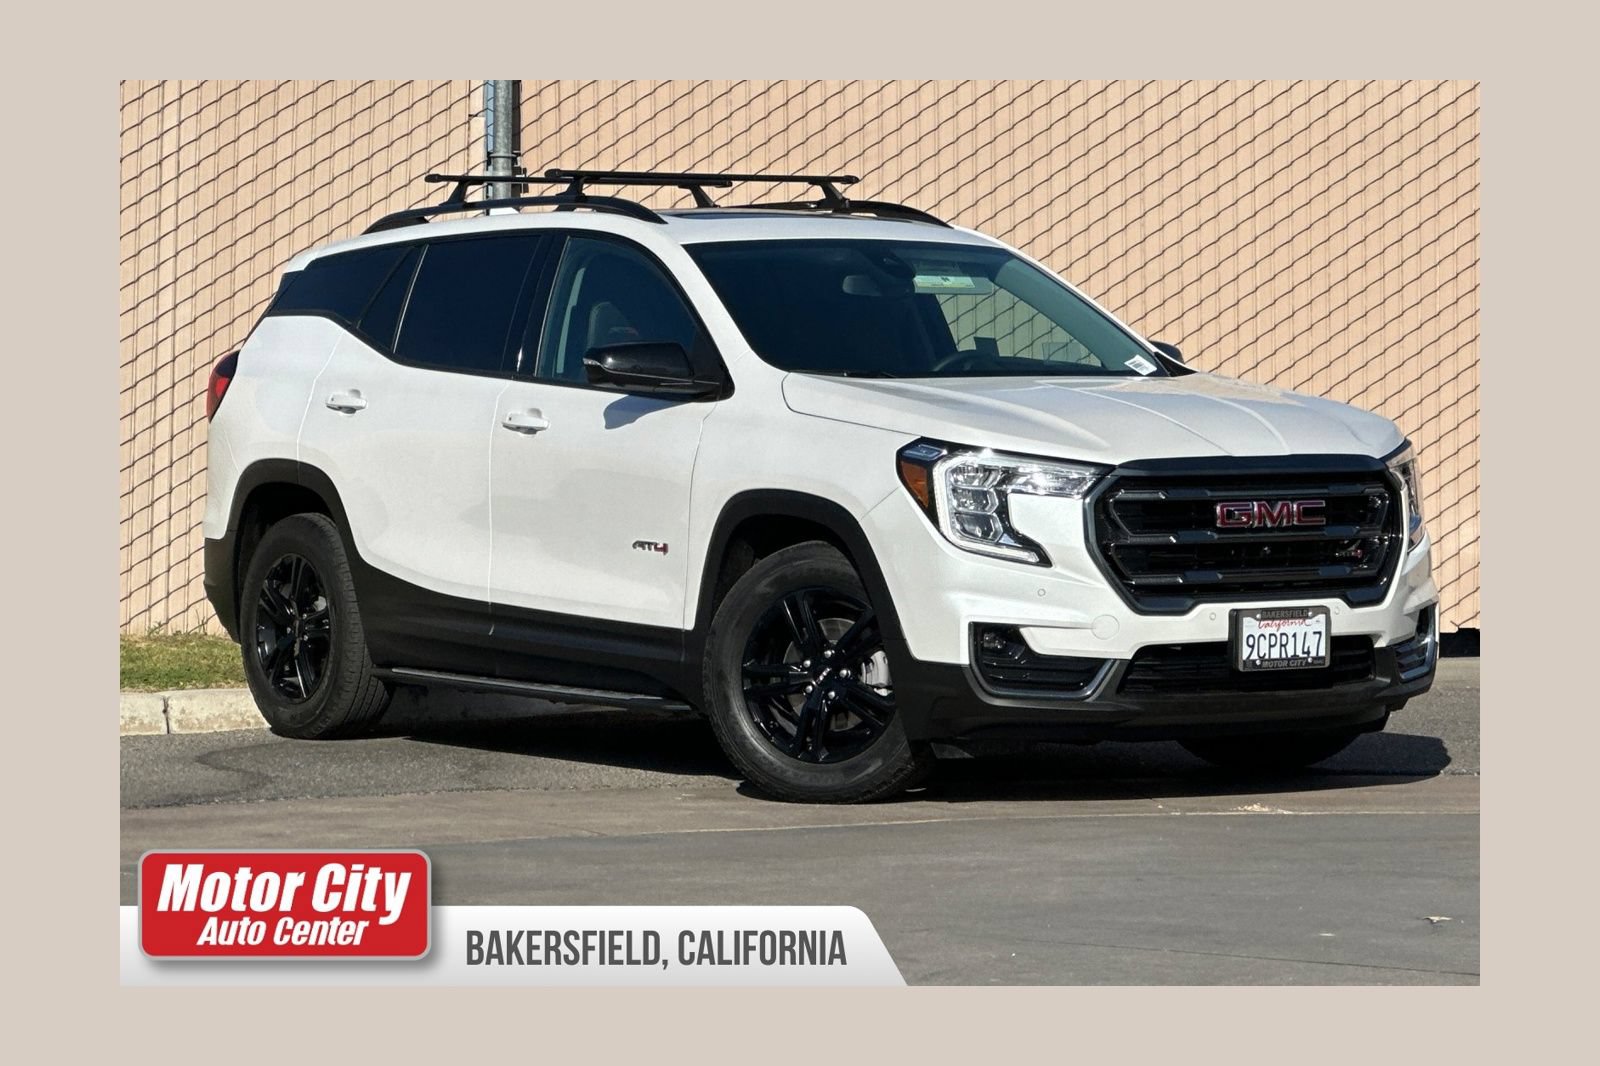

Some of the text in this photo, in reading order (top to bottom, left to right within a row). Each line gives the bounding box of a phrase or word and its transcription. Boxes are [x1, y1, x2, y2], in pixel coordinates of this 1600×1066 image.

[1217, 500, 1326, 527] GMC
[632, 540, 669, 556] AT4
[1262, 609, 1308, 619] BAKERSFIELD
[1246, 631, 1322, 660] 9CPR147
[1262, 660, 1288, 668] MOTOR
[1289, 659, 1307, 667] CITY
